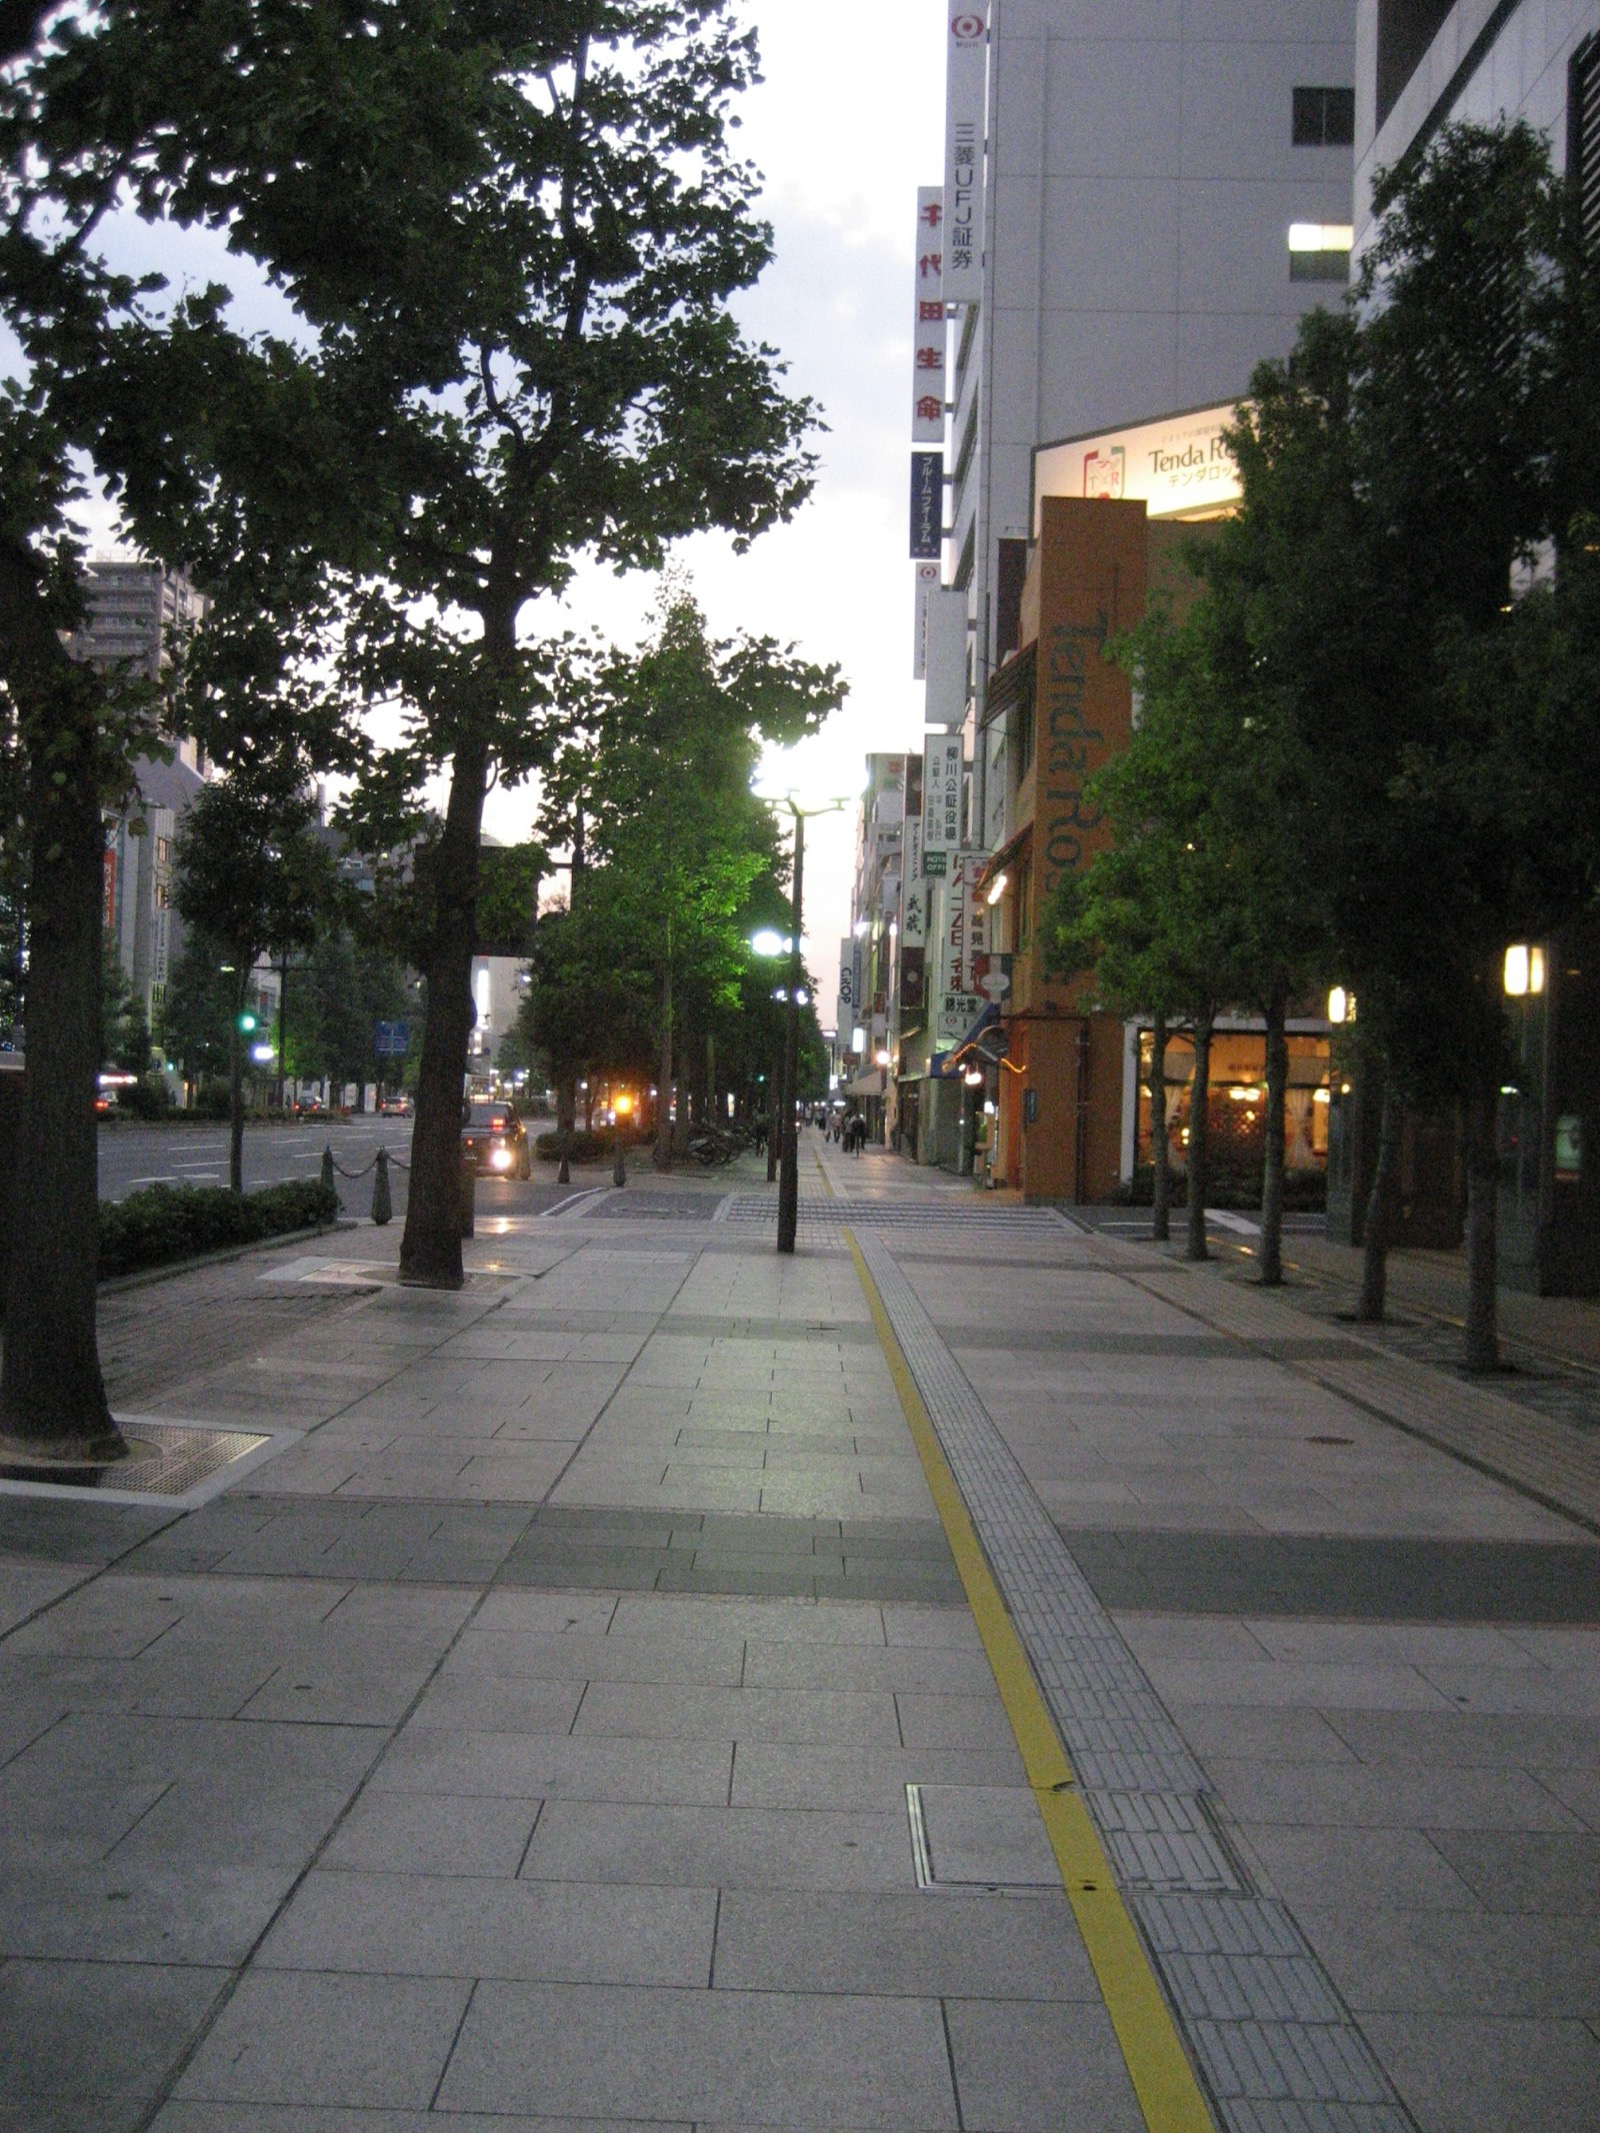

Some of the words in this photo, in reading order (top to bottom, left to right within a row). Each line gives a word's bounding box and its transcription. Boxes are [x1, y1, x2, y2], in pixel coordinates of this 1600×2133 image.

[952, 122, 975, 270] 三菱UFJ証券
[916, 203, 943, 421] 千代田生命
[1148, 444, 1204, 474] Tenda
[1168, 465, 1233, 488] テンダロッ
[926, 855, 946, 863] NOTA
[926, 863, 946, 871] OFFI
